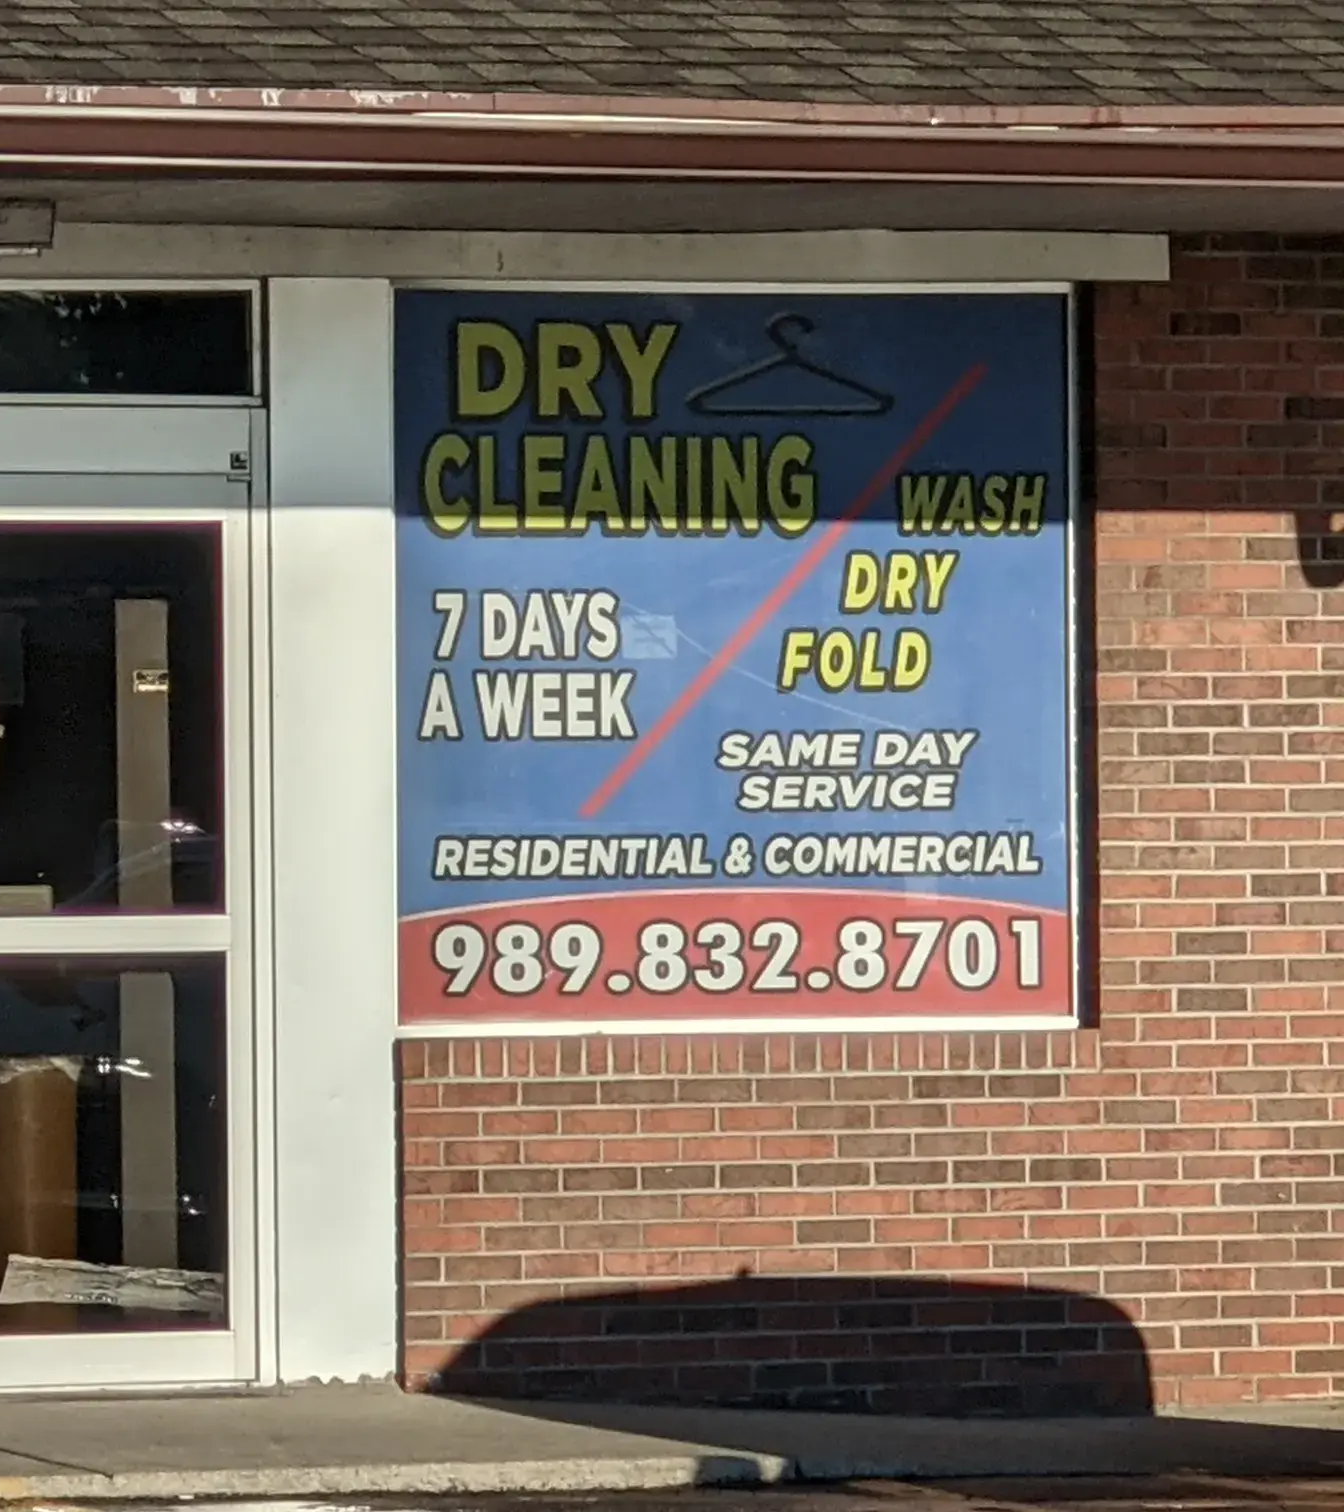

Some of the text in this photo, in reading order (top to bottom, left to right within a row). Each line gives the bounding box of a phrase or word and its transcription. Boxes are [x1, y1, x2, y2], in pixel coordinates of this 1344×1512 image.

[454, 320, 679, 418] DRY
[423, 432, 816, 534] CLEANING
[899, 473, 1047, 533] WASH
[842, 552, 957, 610] DRY
[433, 590, 619, 660] 7 DAYS
[780, 630, 930, 689] FOLD
[419, 671, 636, 739] A WEEK
[716, 730, 977, 768] SAME DAY
[737, 773, 956, 809] SERVICE
[433, 834, 1041, 877] RESIDENTIAL & COMMERCIAL
[432, 918, 1042, 993] 989.832.8701
